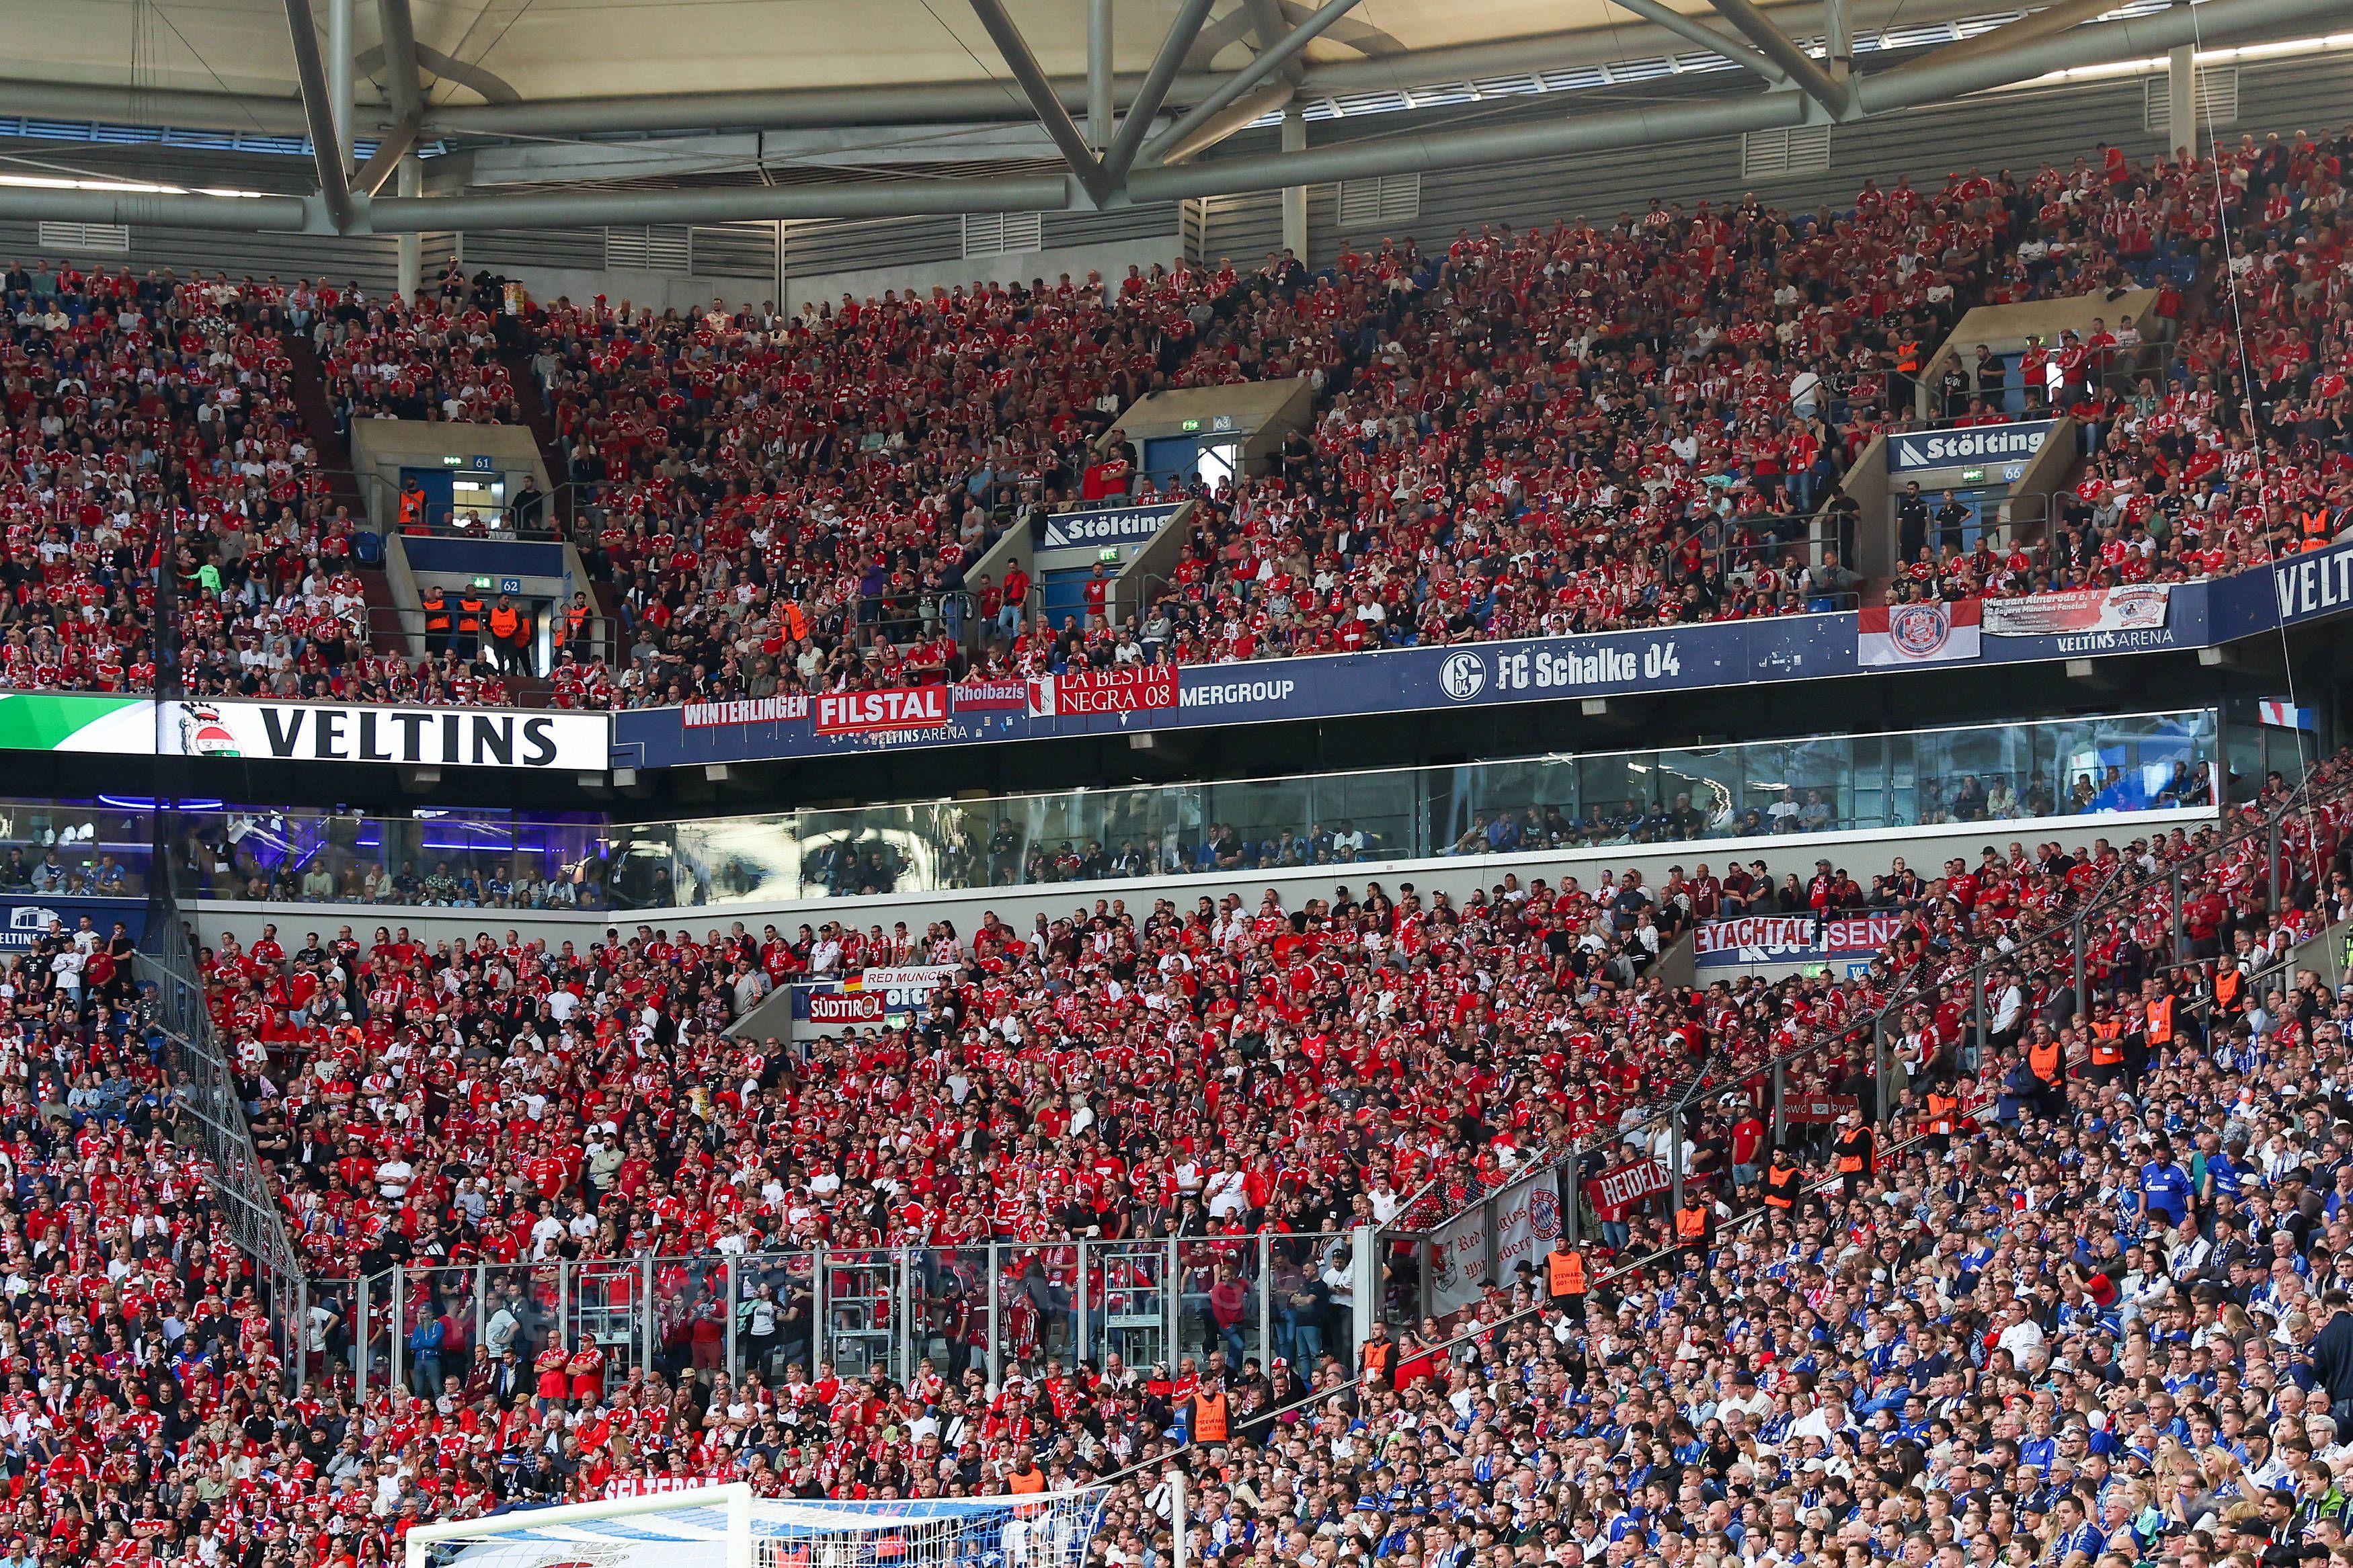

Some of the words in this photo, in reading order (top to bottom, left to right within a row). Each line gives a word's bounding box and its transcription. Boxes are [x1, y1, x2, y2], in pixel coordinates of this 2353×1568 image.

[1926, 430, 2045, 459] Stölting
[475, 458, 489, 468] 61
[2004, 466, 2022, 479] 66
[504, 581, 518, 591] 62
[1984, 598, 2002, 608] Mia
[2026, 593, 2077, 604] Almerode
[2091, 590, 2100, 600] V.
[1994, 607, 2021, 616] Bayern
[2022, 604, 2056, 613] München
[2057, 602, 2087, 610] Fanclub
[2057, 632, 2115, 652] VELTINS
[2117, 629, 2174, 647] ARENA
[1497, 655, 1529, 690] FC
[1536, 647, 1636, 688] Schalke
[1644, 642, 1679, 677] 04
[1061, 671, 1088, 690] LA
[955, 684, 1025, 700] Rhoibazis
[1062, 687, 1138, 712] NEGRA
[1144, 686, 1170, 706] 08
[1180, 679, 1294, 706] MERGROUP
[684, 697, 808, 726] WINTERLINGEN
[822, 691, 947, 725] FILSTAL
[260, 707, 557, 767] VELTINS
[920, 726, 967, 741] ARENA
[1695, 919, 1810, 952] EYACHTAL
[30, 964, 37, 972] T
[868, 973, 893, 983] RED
[811, 995, 882, 1019] SÜDTIROL
[1599, 1163, 1673, 1208] HEIDELB
[1457, 1231, 1480, 1253] Red
[1554, 1272, 1582, 1280] STEWARD
